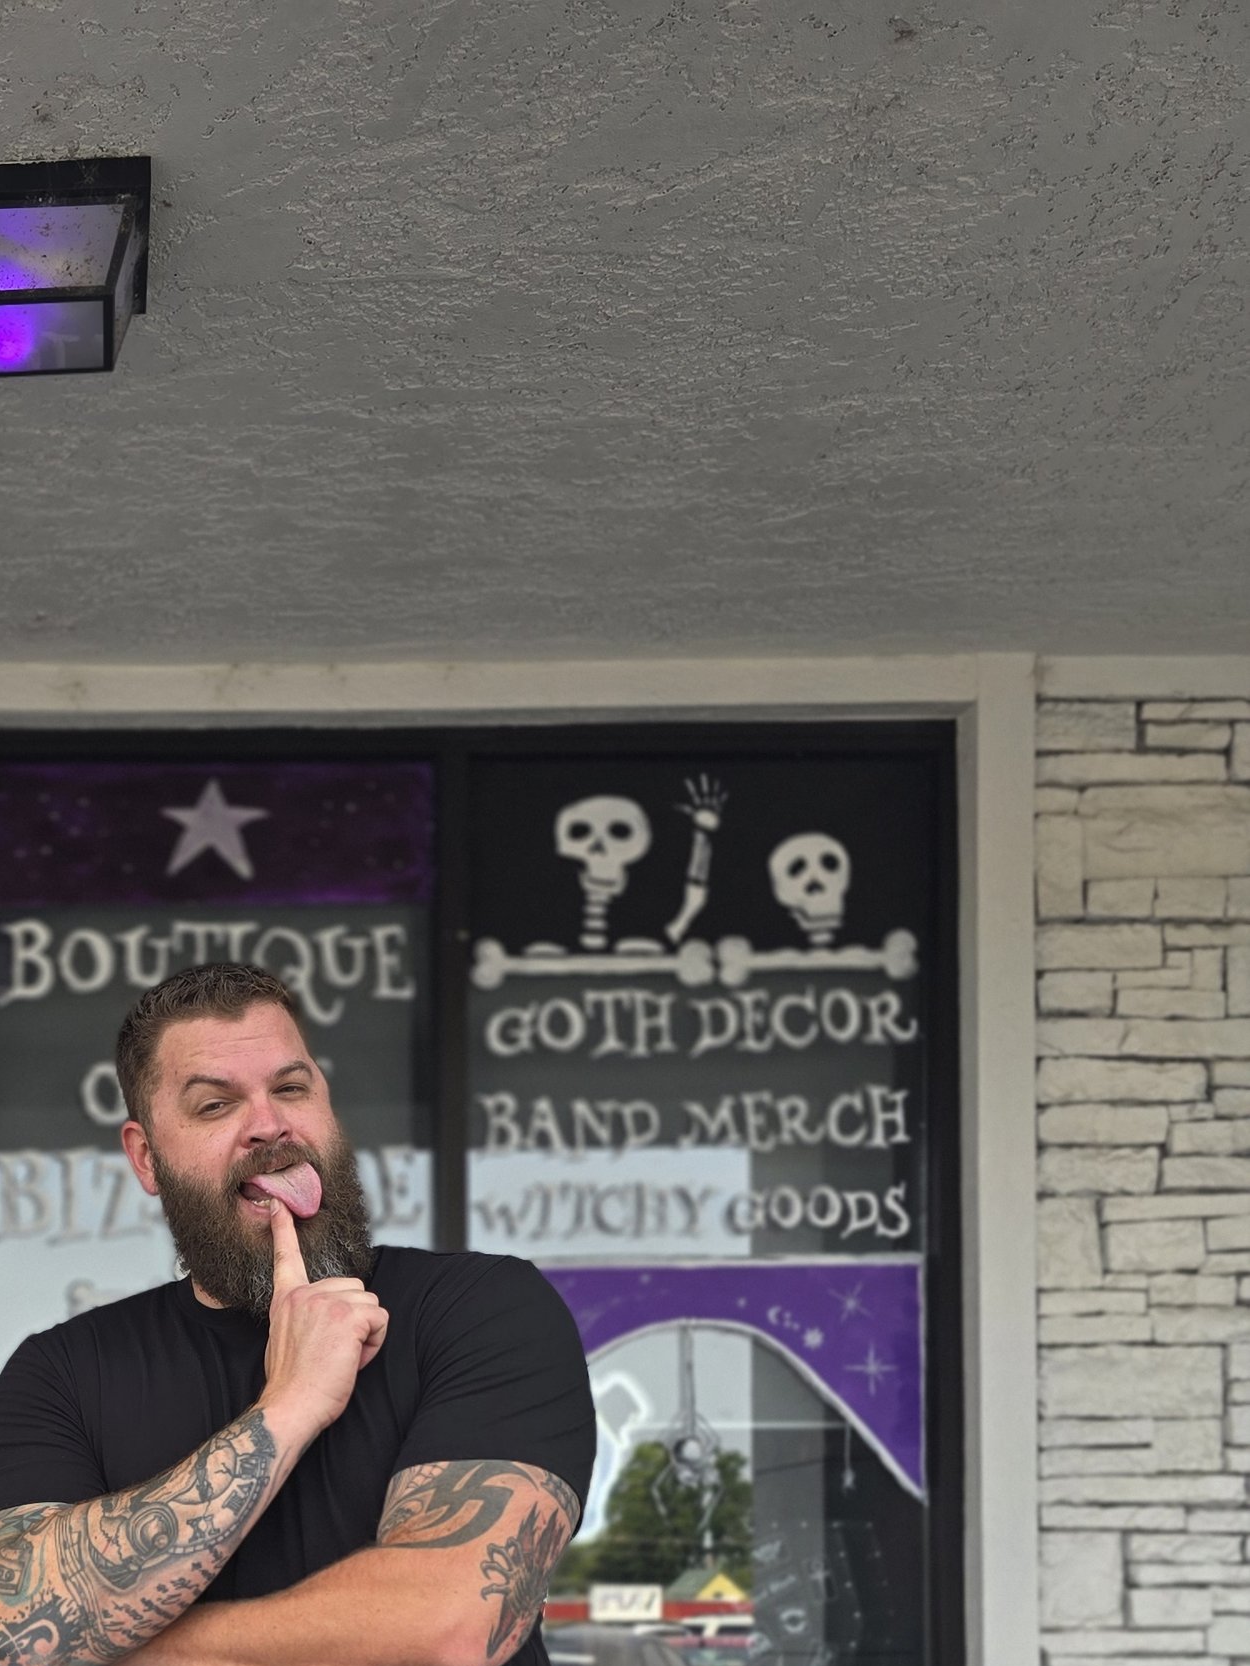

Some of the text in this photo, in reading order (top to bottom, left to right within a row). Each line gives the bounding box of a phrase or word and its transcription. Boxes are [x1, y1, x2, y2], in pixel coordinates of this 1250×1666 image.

[485, 988, 918, 1057] GOTH DECOR
[476, 1085, 911, 1164] BAND MERCH
[471, 1179, 911, 1241] WITCHY GOODS
